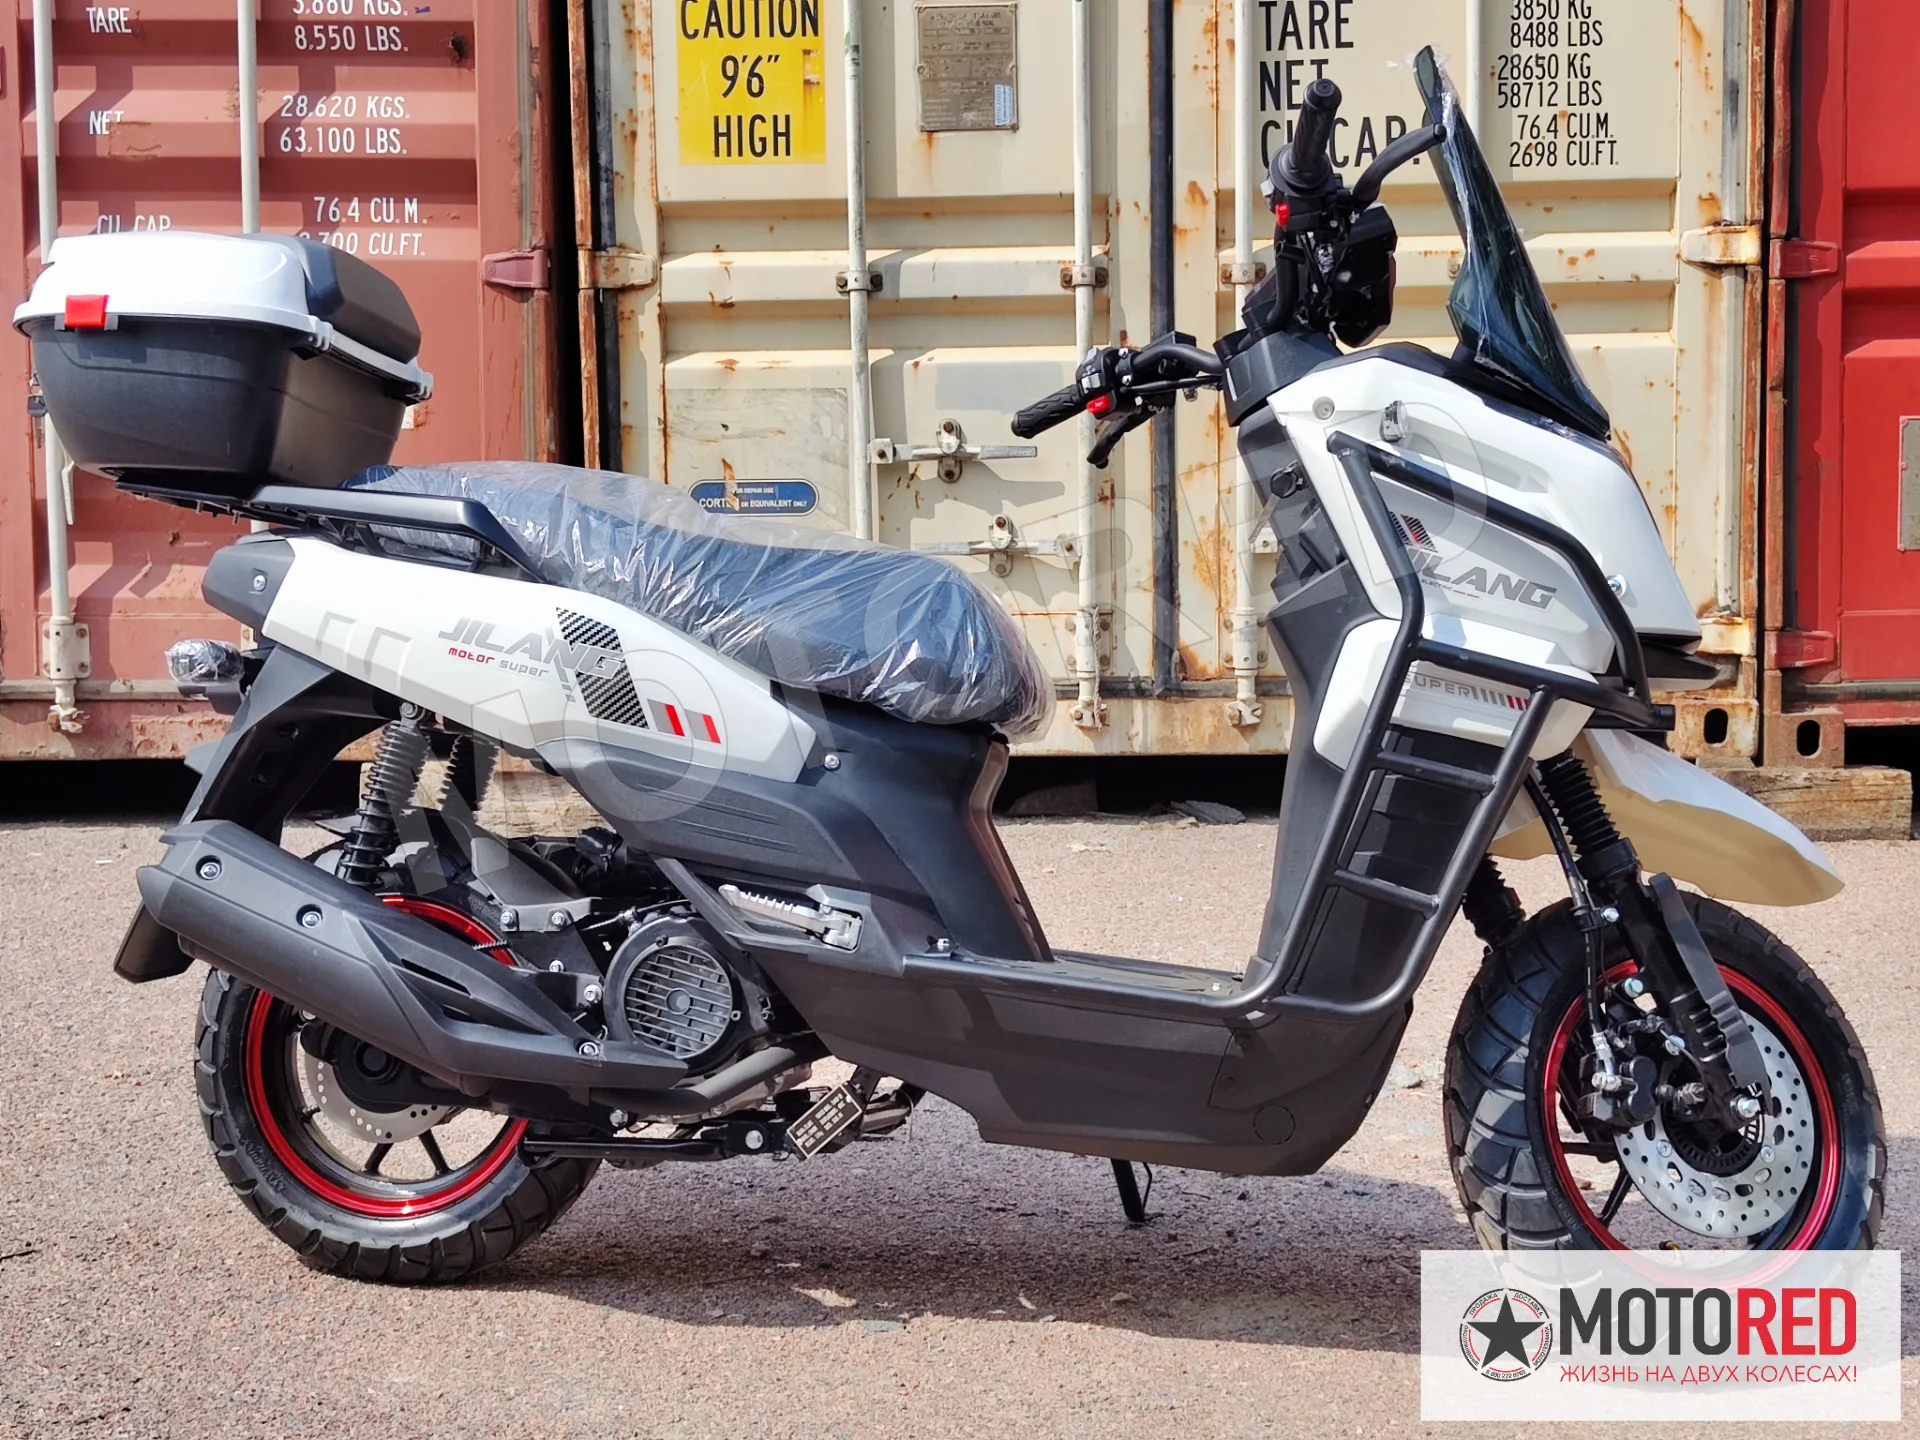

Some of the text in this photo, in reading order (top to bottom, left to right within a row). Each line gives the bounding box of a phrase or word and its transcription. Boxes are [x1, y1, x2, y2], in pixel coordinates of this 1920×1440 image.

[86, 7, 132, 34] TARE
[363, 0, 408, 16] KGS.
[681, 0, 819, 40] CAUTION
[1510, 0, 1592, 21] 3850 KG
[294, 24, 409, 52] 8,550 LBS.
[1258, 0, 1354, 51] TARE
[1510, 20, 1603, 49] 8488 LBS
[1497, 52, 1591, 81] 28650 KG
[280, 94, 411, 119] 28,620 KGS.
[1498, 80, 1602, 109] 58712 LBS
[280, 127, 407, 154] 63,100 LBS.
[713, 113, 791, 158] HIGH
[1517, 113, 1559, 140] 76.4
[1509, 140, 1619, 168] 2698 CU.FT.
[313, 196, 361, 223] 76.4
[750, 499, 793, 508] EQUIVALENT
[437, 616, 626, 680] JILANG
[447, 646, 550, 678] motor super
